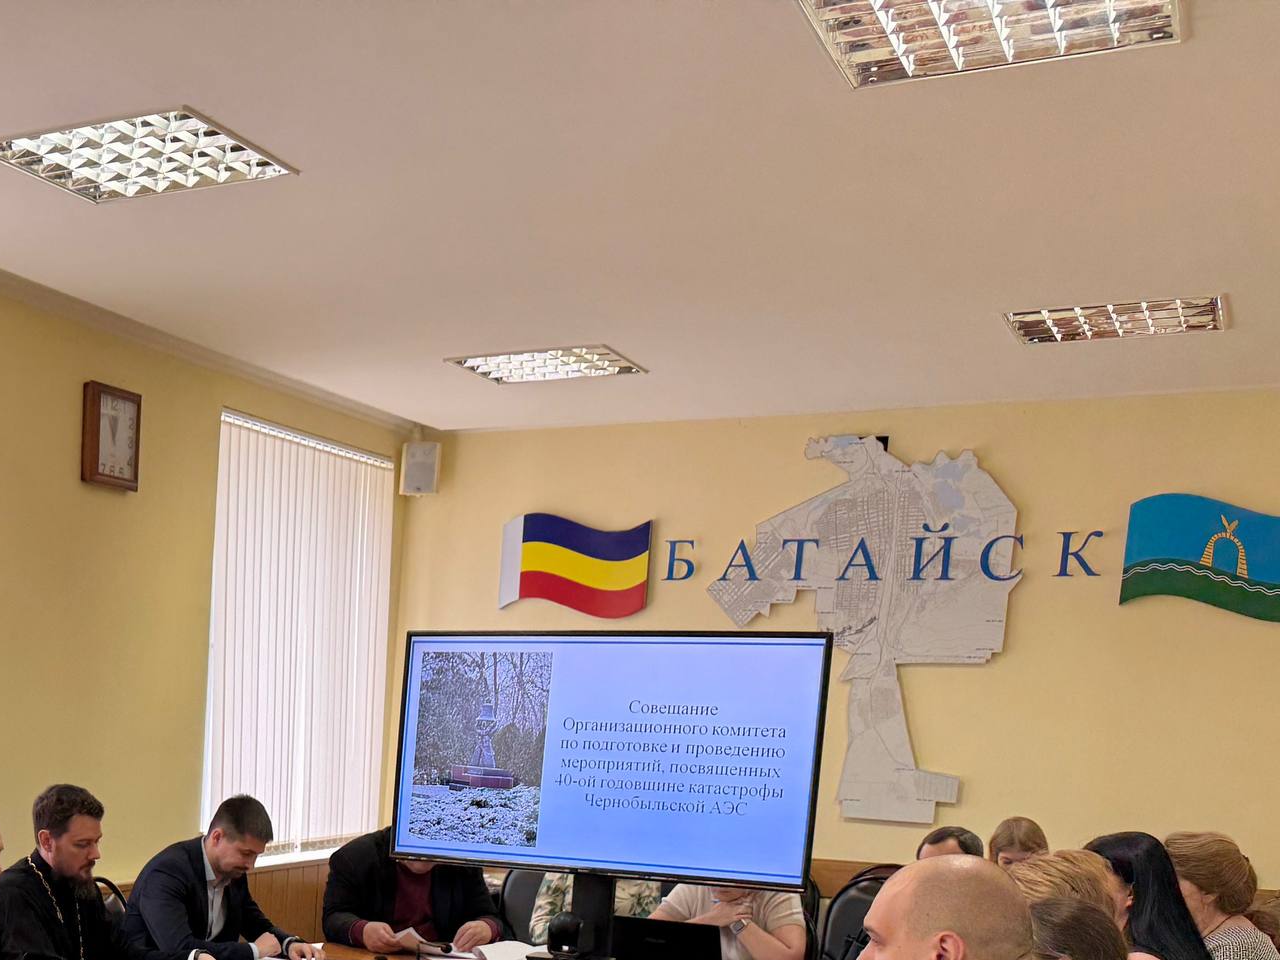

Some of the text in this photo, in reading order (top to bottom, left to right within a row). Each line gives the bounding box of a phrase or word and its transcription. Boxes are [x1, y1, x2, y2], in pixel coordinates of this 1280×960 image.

[661, 522, 1105, 583] БАТАЙСК
[628, 699, 719, 716] Совещание
[563, 717, 787, 739] Организационного комитета
[560, 739, 786, 759] по подготовке и проведению
[560, 758, 782, 779] мероприятий, посвященных
[554, 773, 784, 801] 40-ой годовщине катастрофы
[584, 793, 749, 816] Чернобыльской АЭС
